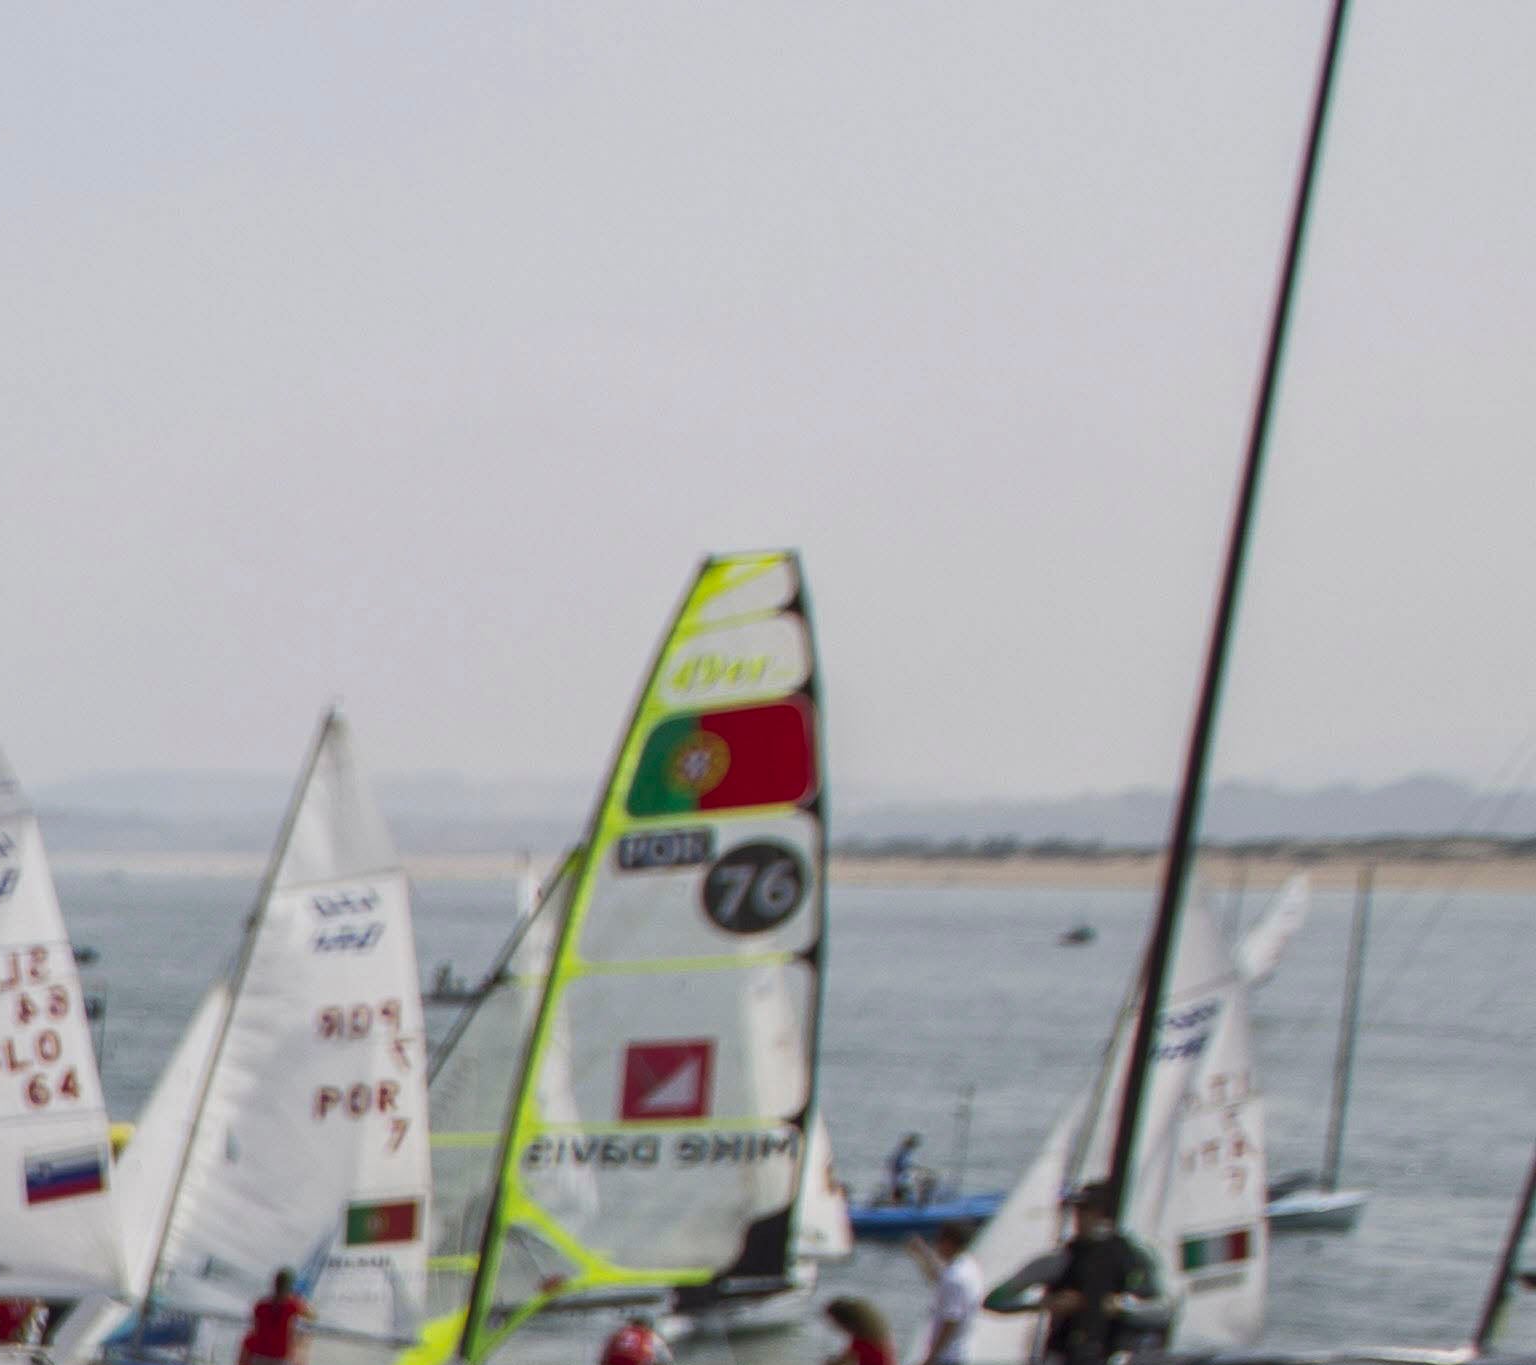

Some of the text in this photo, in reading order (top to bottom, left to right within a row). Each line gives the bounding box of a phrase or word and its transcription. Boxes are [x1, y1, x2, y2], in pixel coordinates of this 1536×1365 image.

[714, 860, 800, 922] 76
[24, 1064, 80, 1107] 64
[312, 1081, 400, 1119] POR
